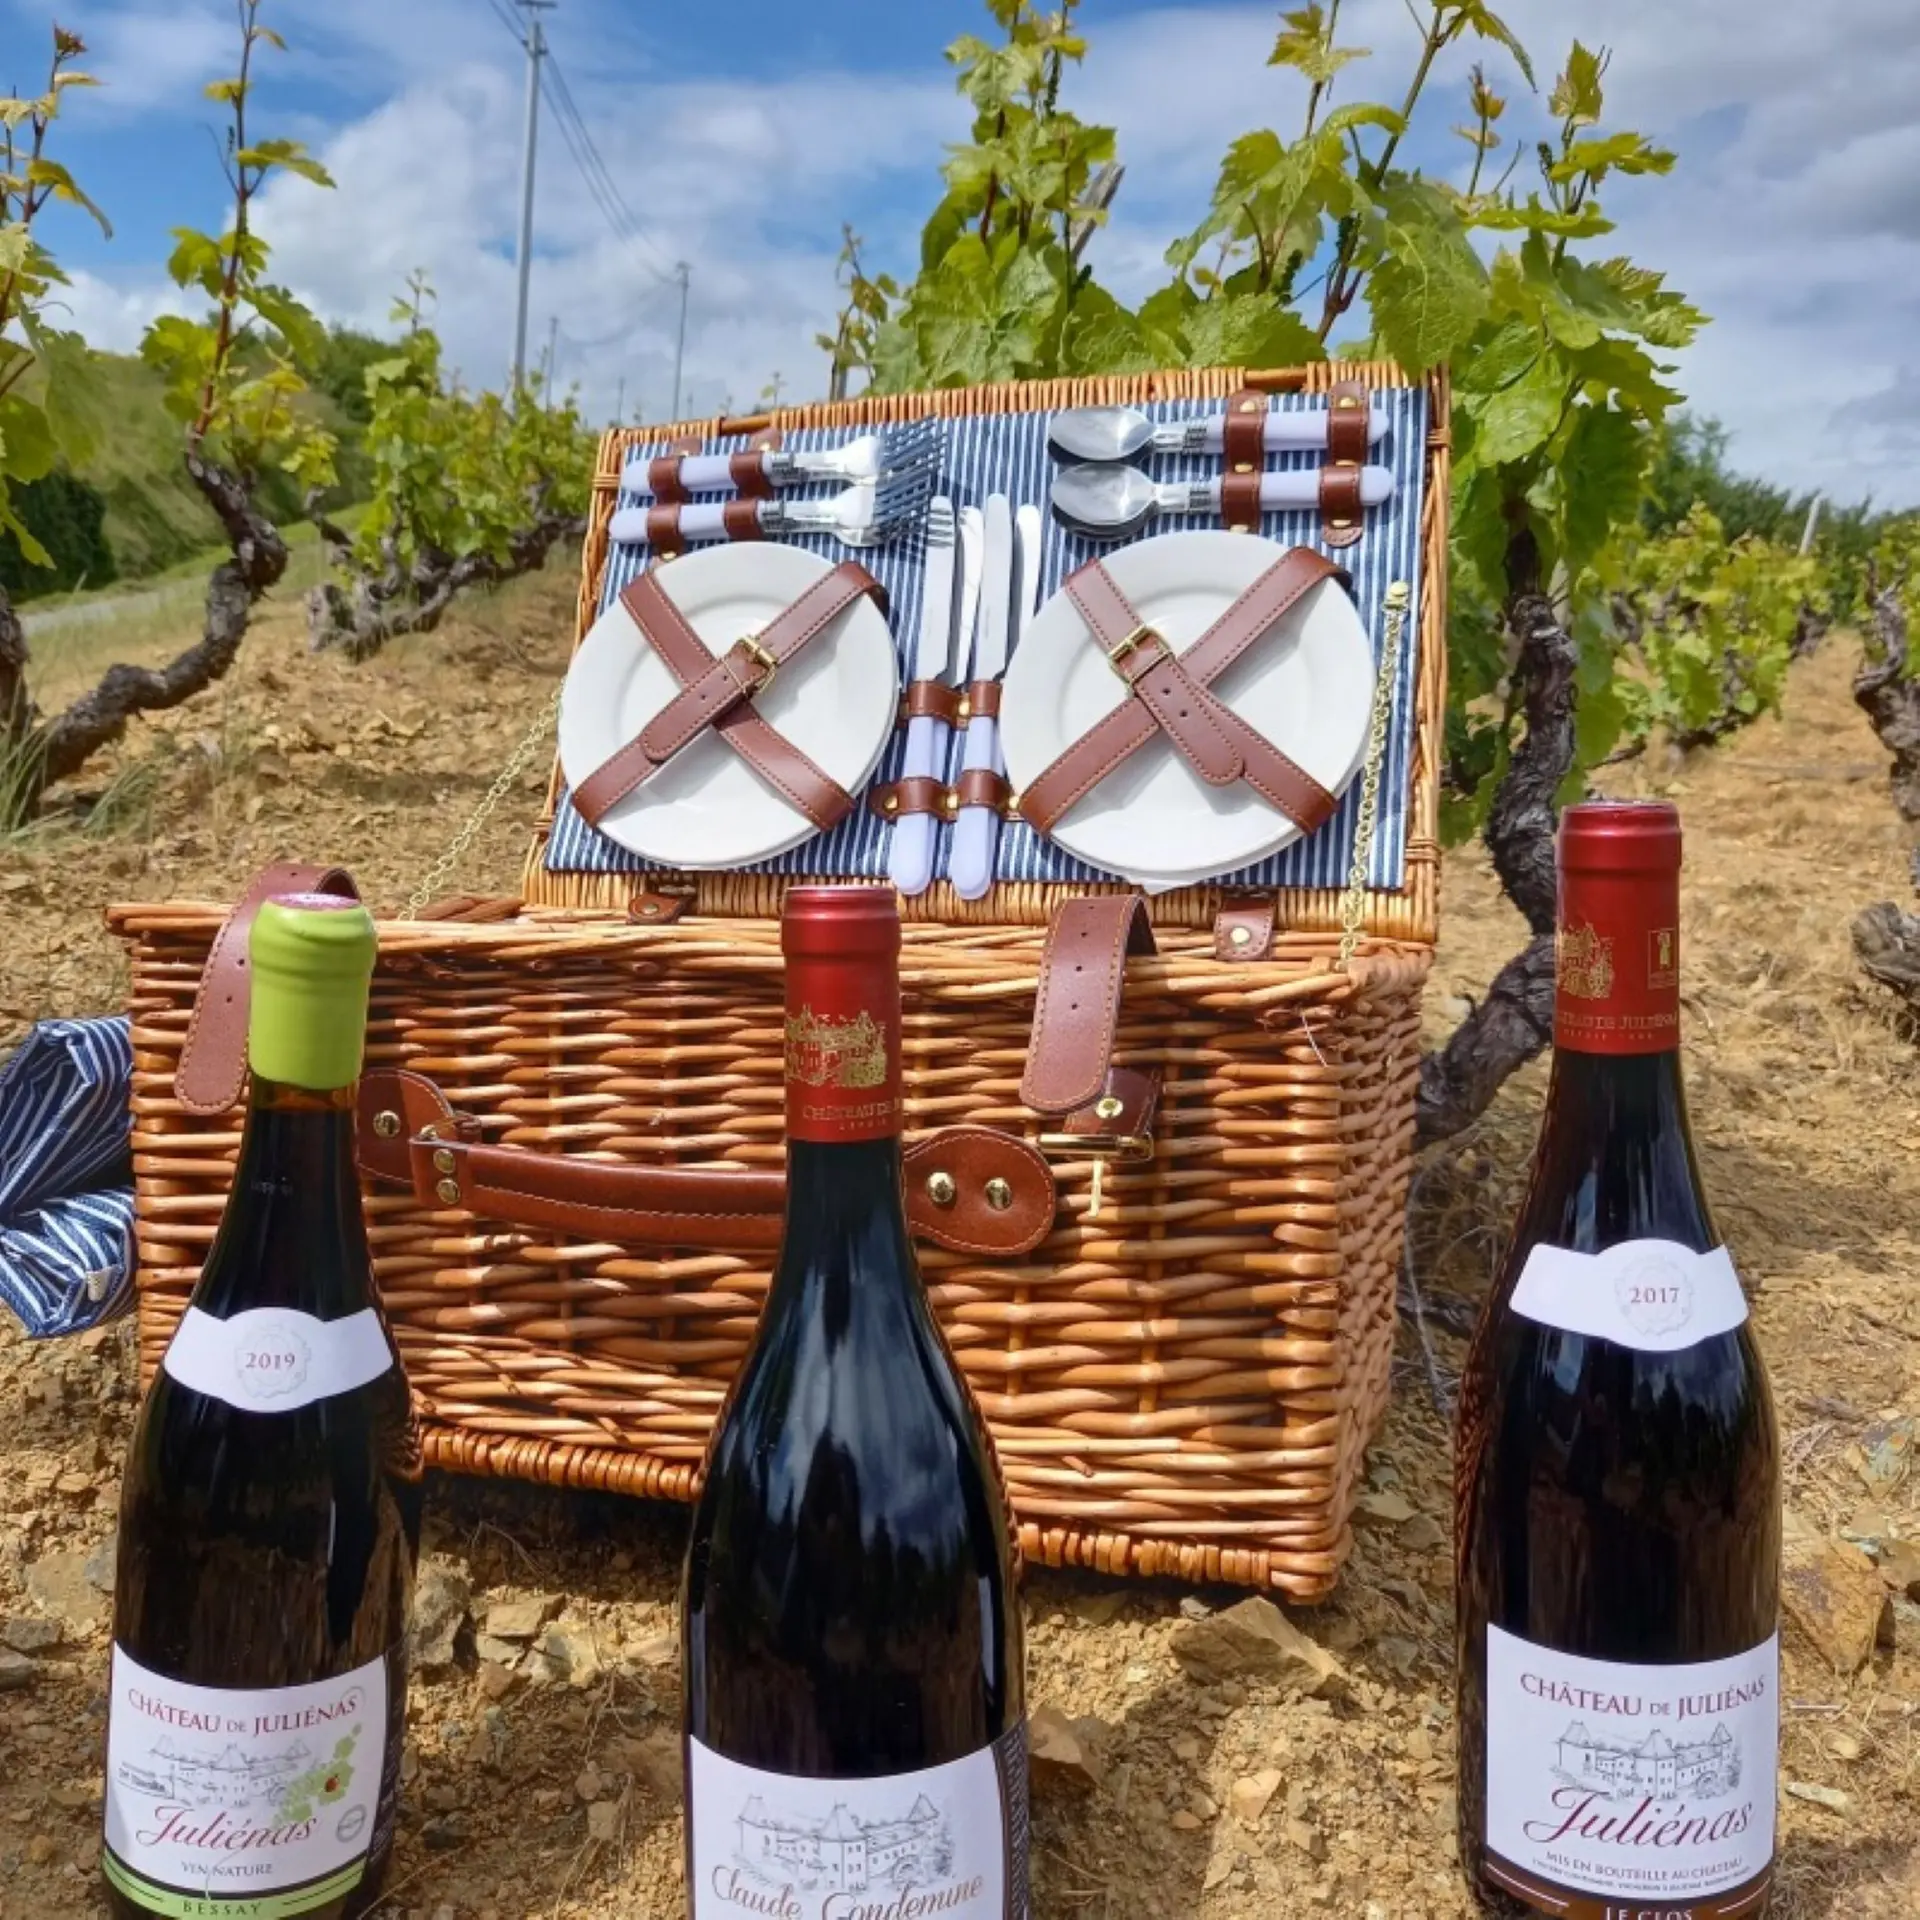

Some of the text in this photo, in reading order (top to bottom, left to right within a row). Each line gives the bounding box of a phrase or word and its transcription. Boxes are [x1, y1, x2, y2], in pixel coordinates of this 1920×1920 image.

[1629, 1286, 1680, 1304] 2017
[245, 1352, 295, 1370] 2019
[128, 1688, 358, 1738] CHÂTEAU DE JULIÉNAS
[1520, 1672, 1764, 1722] CHÂTEAU DE JULIÉNAS
[136, 1806, 317, 1850] Juliénas
[1522, 1787, 1753, 1848] Juliénas
[181, 1860, 274, 1877] VIN NATURE
[1546, 1851, 1570, 1867] MIS
[1573, 1858, 1591, 1873] EN
[1595, 1863, 1667, 1881] BOUTEILLE
[183, 1901, 262, 1916] BESSAY
[712, 1864, 802, 1919] Claude
